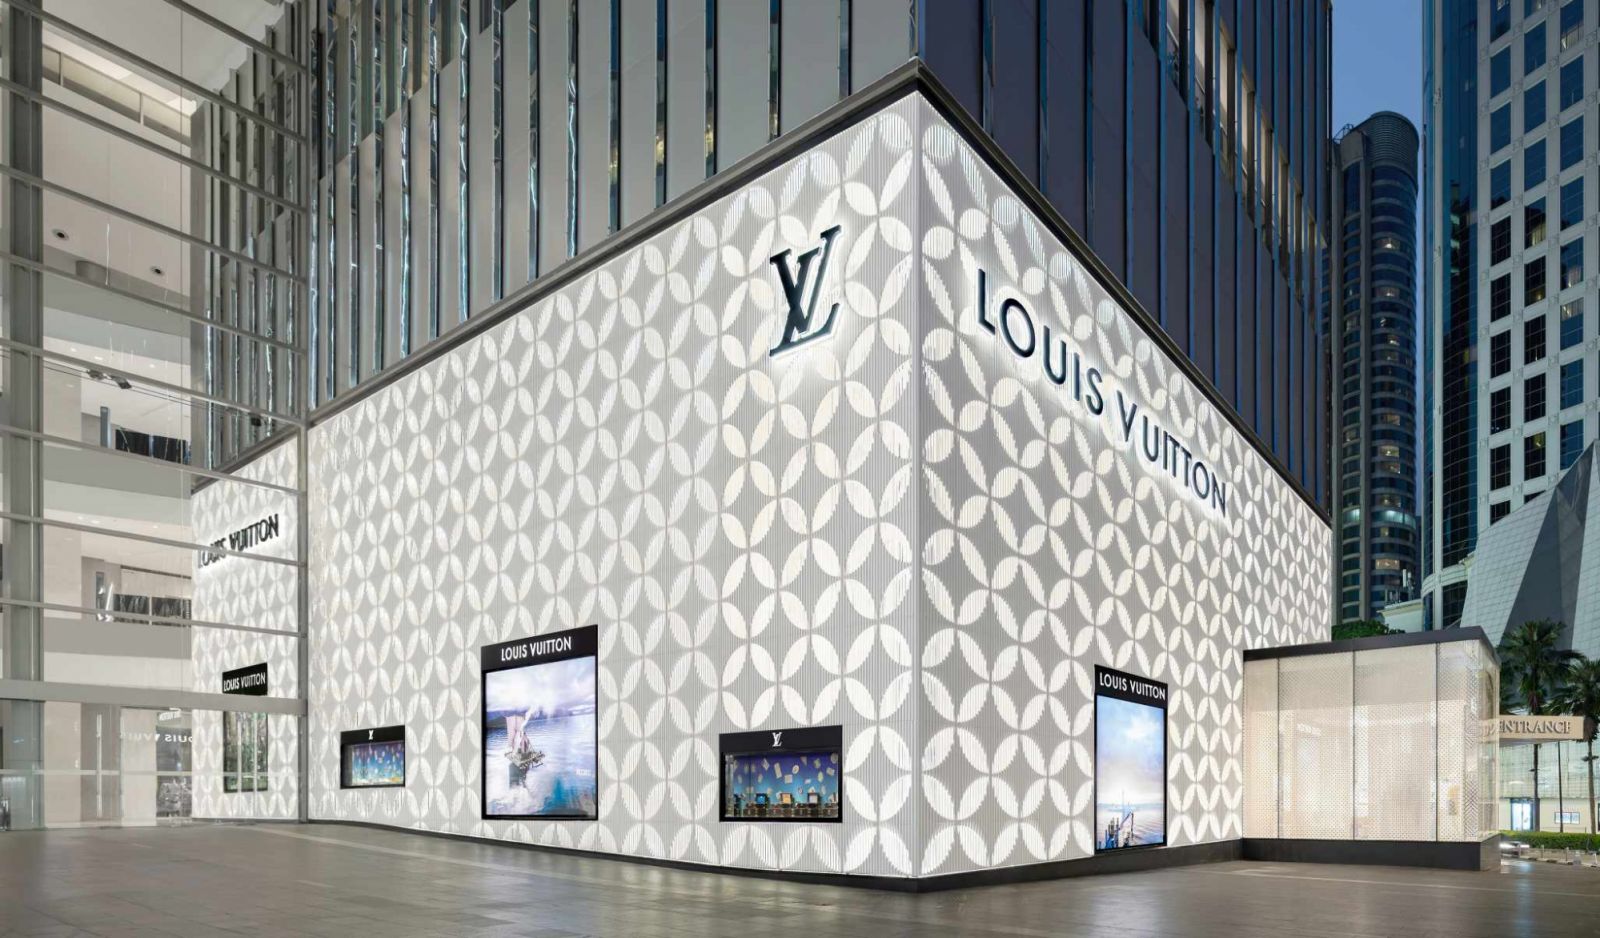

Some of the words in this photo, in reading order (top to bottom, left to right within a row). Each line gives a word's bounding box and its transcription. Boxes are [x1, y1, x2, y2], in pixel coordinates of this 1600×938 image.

[978, 268, 1104, 416] LOUIS
[1117, 390, 1227, 519] VUITTON
[229, 513, 279, 551] VUITTON
[501, 643, 528, 662] LOUIS
[529, 636, 572, 657] VUITTON
[223, 677, 240, 692] LOUIS
[240, 671, 266, 689] VUITTON
[1100, 672, 1128, 692] LOUIS
[1129, 679, 1166, 701] VUITTON
